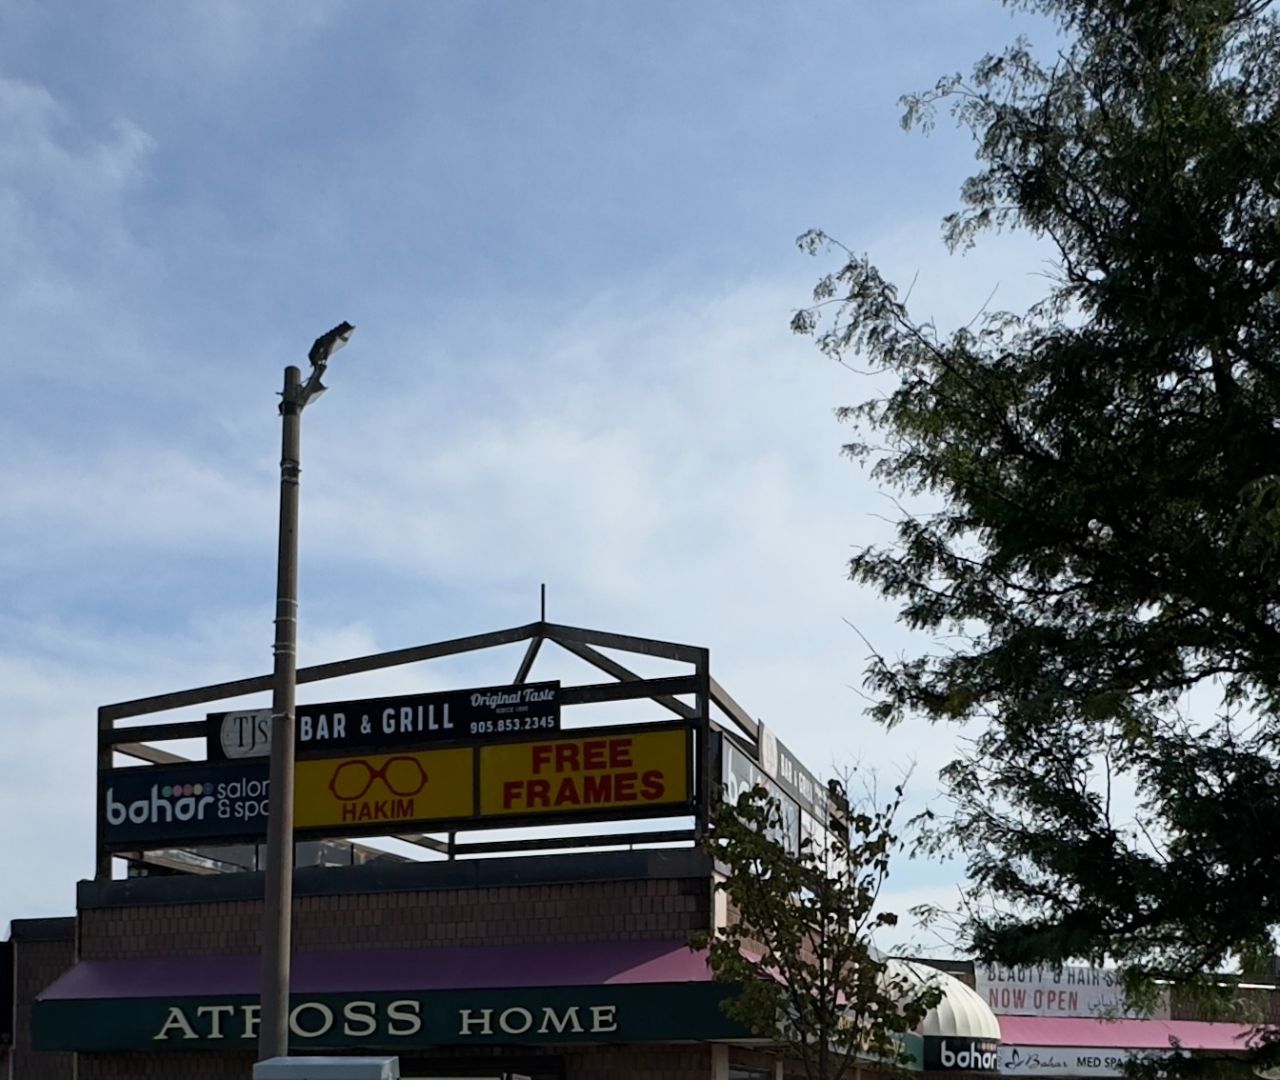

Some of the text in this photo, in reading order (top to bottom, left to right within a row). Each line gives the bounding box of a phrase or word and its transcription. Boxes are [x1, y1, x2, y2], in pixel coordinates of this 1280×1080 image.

[470, 690, 521, 709] Original
[523, 688, 556, 703] Taste
[300, 703, 454, 741] BAR & GRILL
[470, 715, 555, 734] 905.853.2345
[532, 738, 632, 774] FREE
[503, 770, 665, 810] FRAMES
[106, 784, 215, 825] bahar
[218, 800, 230, 818] &
[342, 799, 414, 822] HAKIM
[987, 966, 1044, 983] BEAUTY
[1067, 968, 1100, 986] HAIR
[989, 988, 1078, 1010] NOW OPEN
[458, 1005, 618, 1036] HOME
[940, 1040, 997, 1069] bahar
[1076, 1056, 1101, 1068] MED
[1104, 1056, 1123, 1068] SPA
